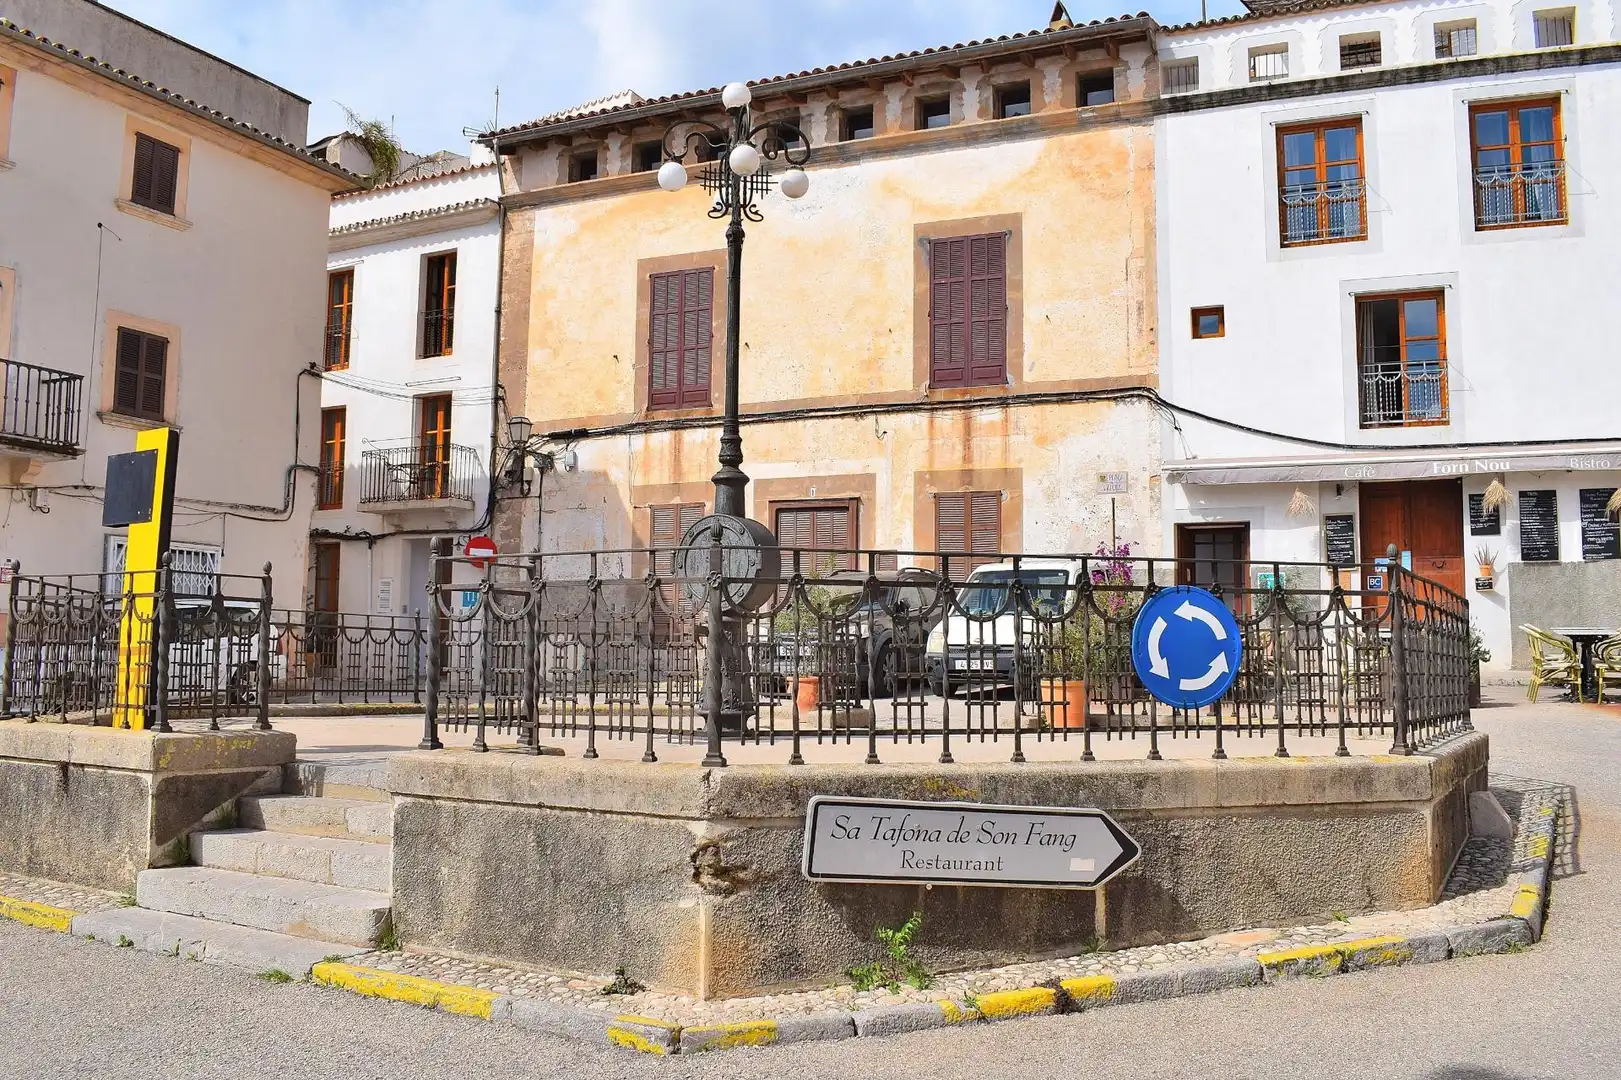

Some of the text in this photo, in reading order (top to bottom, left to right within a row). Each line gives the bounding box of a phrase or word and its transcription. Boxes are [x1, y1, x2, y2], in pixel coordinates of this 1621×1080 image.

[1433, 462, 1468, 474] Forn
[1475, 459, 1510, 472] Nou
[1570, 457, 1610, 469] Bistro
[830, 813, 1077, 852] Sa Tafona de Son Fang
[900, 848, 1004, 872] Restaurant
